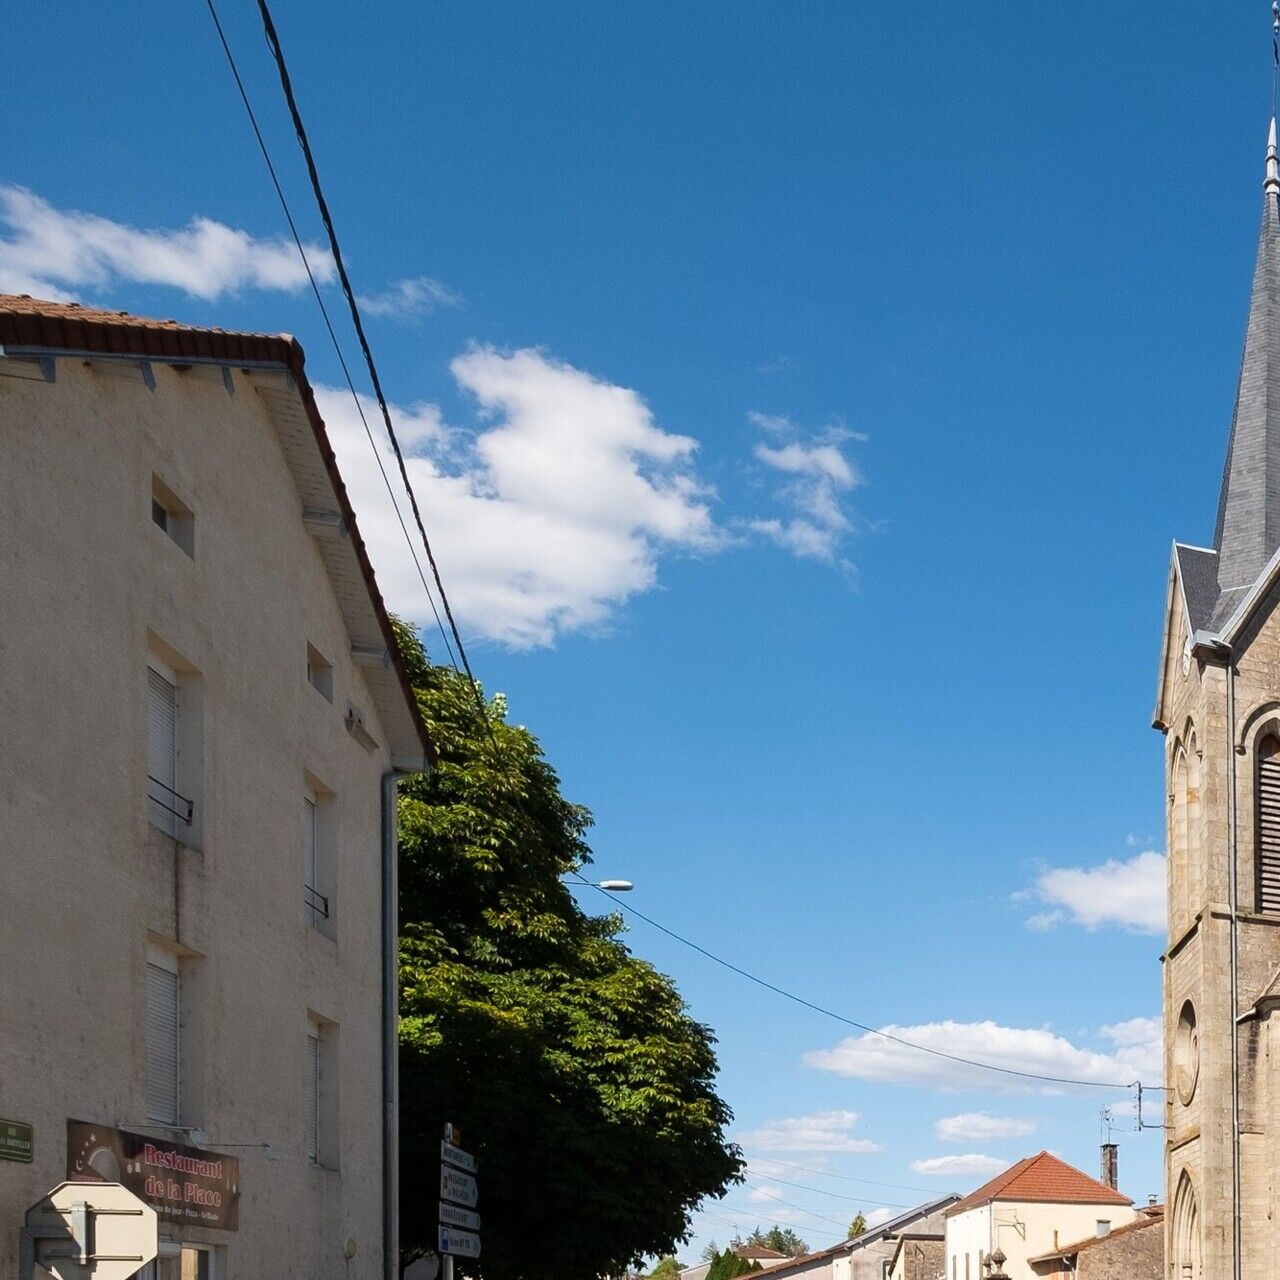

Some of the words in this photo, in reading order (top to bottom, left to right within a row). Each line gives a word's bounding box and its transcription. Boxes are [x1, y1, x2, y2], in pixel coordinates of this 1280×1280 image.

[144, 1143, 223, 1180] Restaurant
[145, 1176, 164, 1198] de
[167, 1179, 182, 1201] la
[184, 1182, 222, 1208] Place
